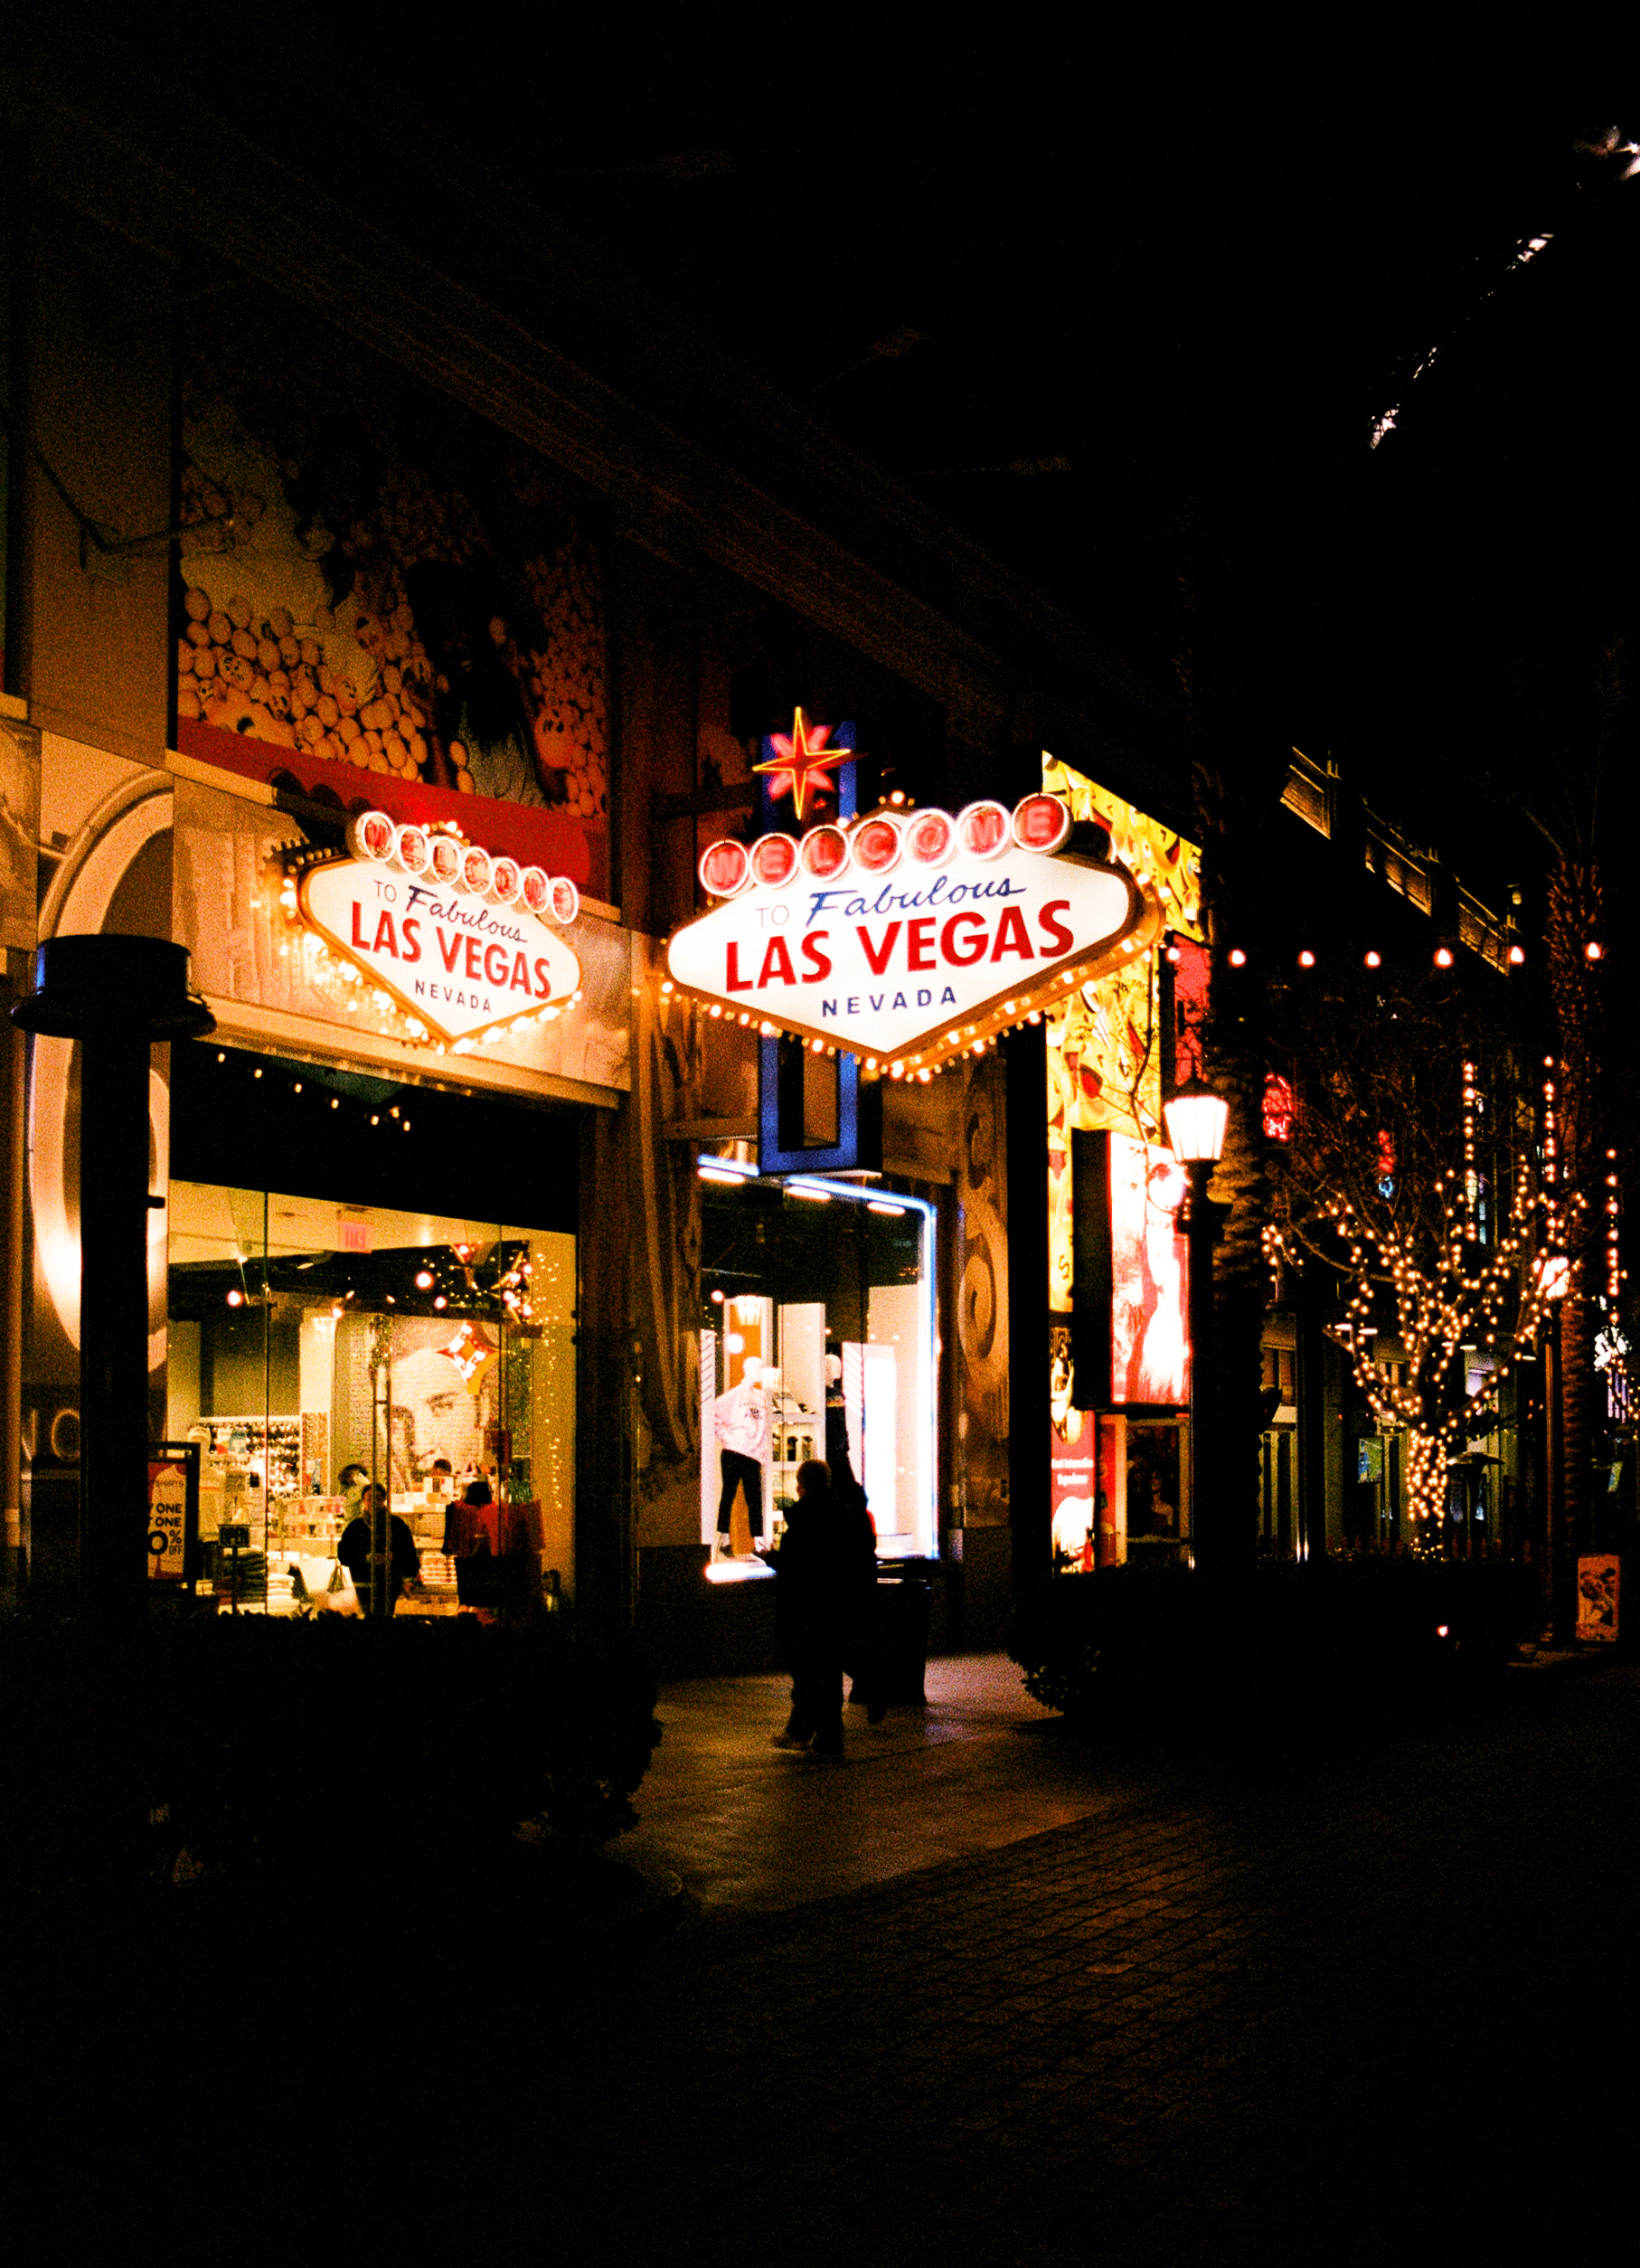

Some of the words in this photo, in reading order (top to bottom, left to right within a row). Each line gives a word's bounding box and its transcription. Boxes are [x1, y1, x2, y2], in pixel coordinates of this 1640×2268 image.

[710, 799, 1060, 890] WELCOME
[364, 818, 571, 920] WELCOME
[373, 880, 396, 902] TO
[406, 884, 527, 942] Fabulous
[755, 904, 789, 929] TO
[806, 875, 1027, 927] Fabulous
[351, 901, 421, 964] LAS
[436, 926, 551, 1001] VEGAS
[725, 931, 833, 993] LAS
[855, 900, 1075, 977] VEGAS
[415, 978, 492, 1013] NEVADA
[822, 986, 957, 1017] NEVADA
[155, 1517, 182, 1527] ONE
[156, 1503, 183, 1514] ONE
[169, 1545, 183, 1555] OFF
[220, 1528, 249, 1545] OPEN
